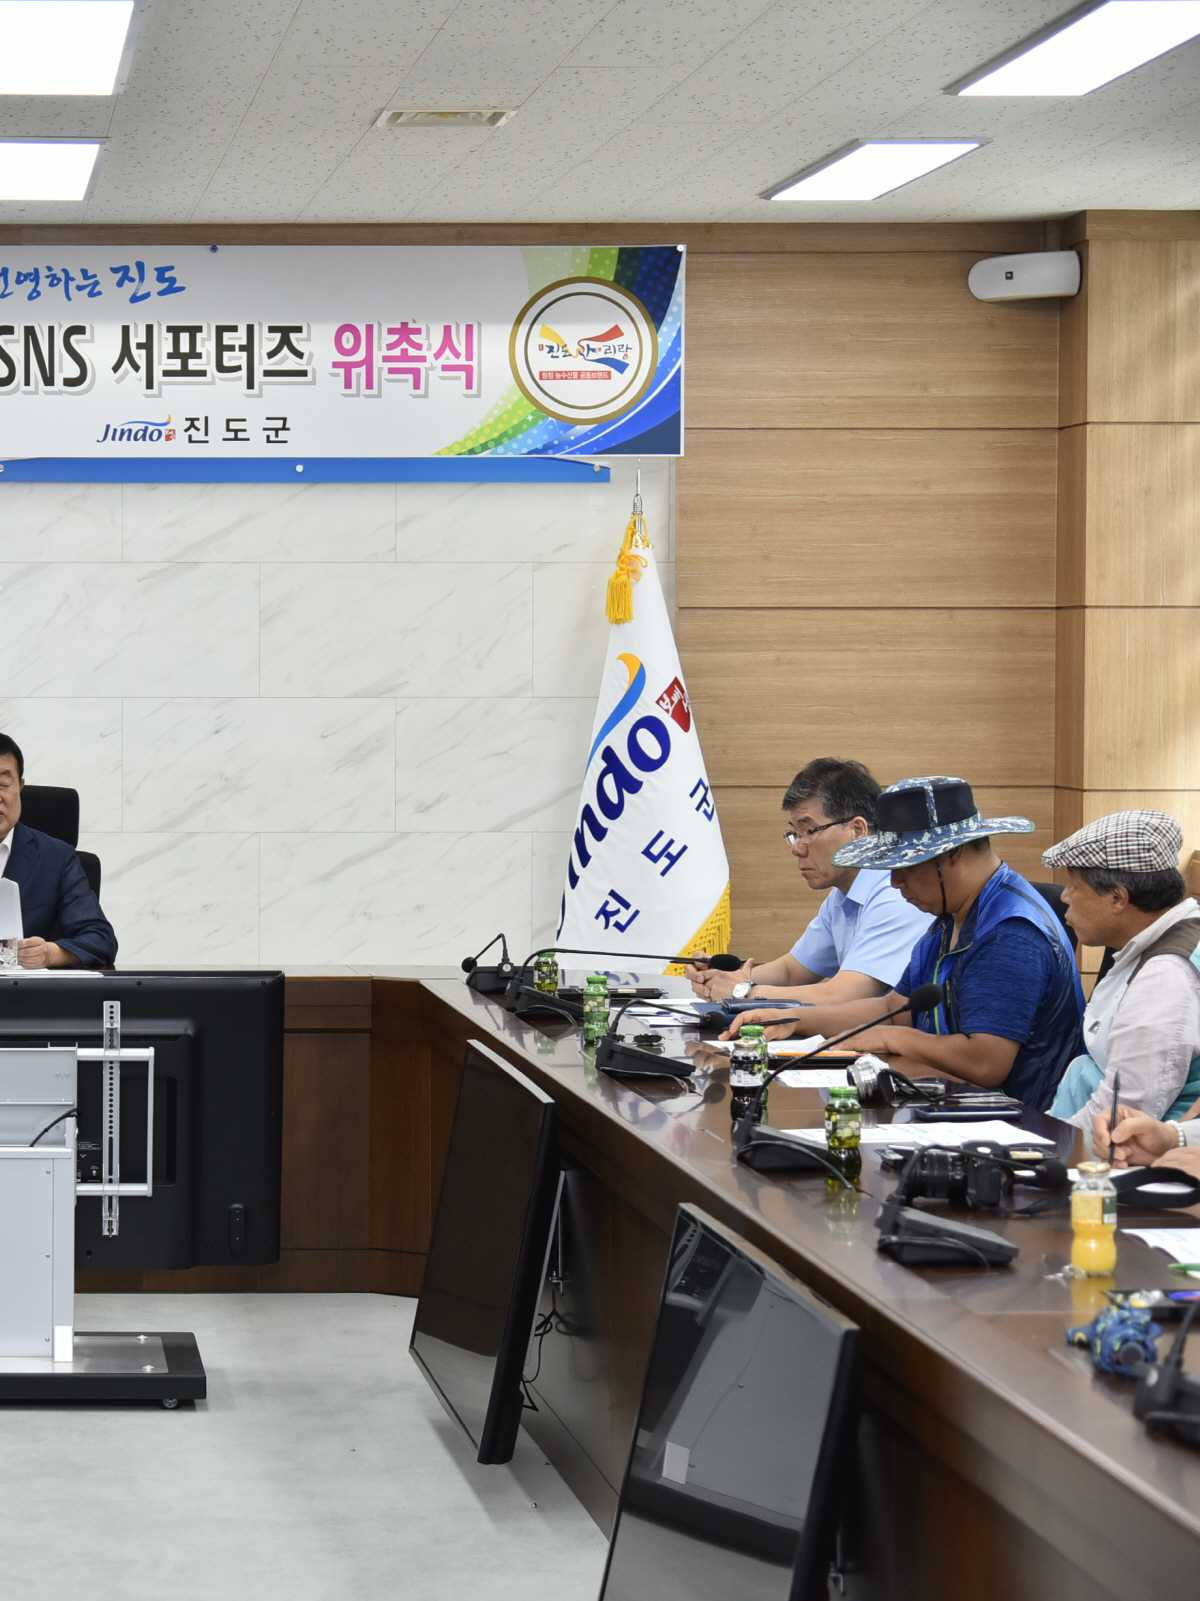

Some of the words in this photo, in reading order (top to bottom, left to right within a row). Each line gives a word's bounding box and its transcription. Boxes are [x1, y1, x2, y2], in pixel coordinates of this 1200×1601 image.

[109, 260, 187, 304] 진도
[111, 323, 308, 390] 서포터즈
[331, 321, 475, 390] 위촉식
